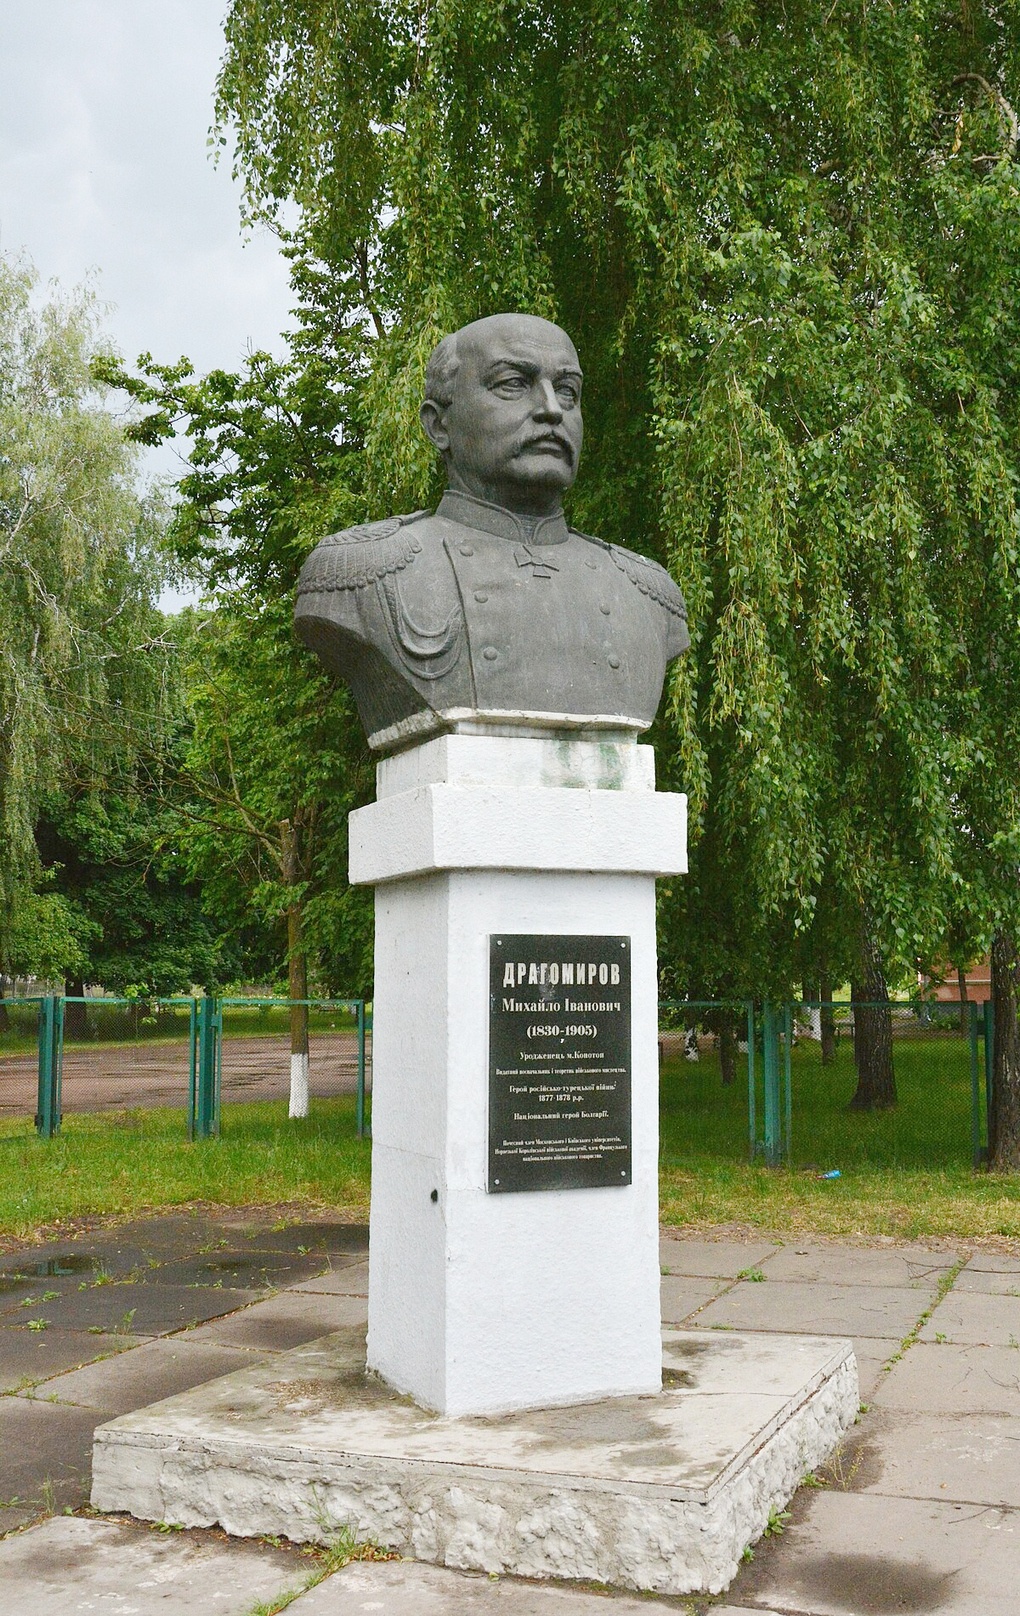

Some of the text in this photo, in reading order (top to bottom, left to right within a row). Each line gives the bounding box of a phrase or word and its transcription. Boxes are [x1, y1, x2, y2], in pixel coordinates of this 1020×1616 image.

[502, 962, 620, 988] ДРАГОМИРОВ
[502, 998, 621, 1012] Михайло Іванович
[526, 1025, 598, 1039] (1830-1905)
[520, 1051, 565, 1061] Уродженець
[509, 1085, 528, 1094] Герой
[513, 1112, 561, 1121] Національний
[561, 1111, 580, 1120] герой
